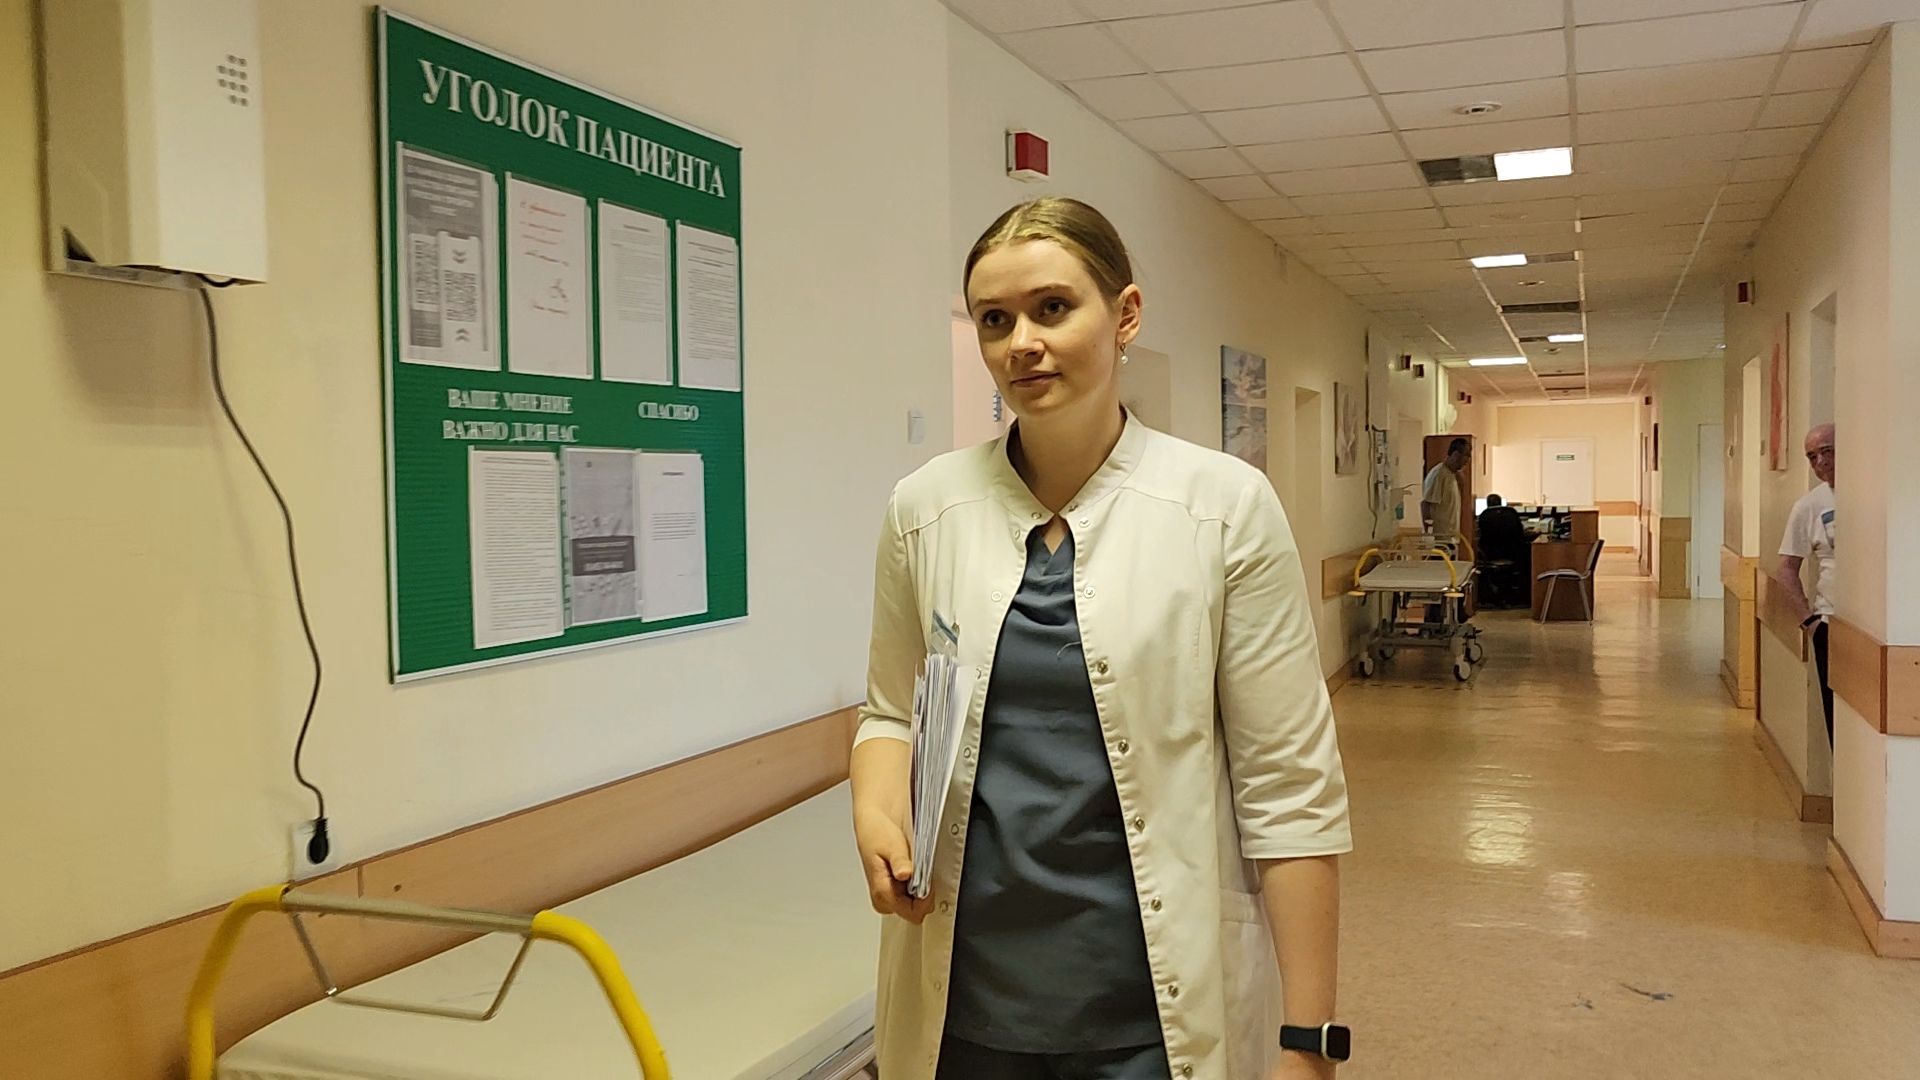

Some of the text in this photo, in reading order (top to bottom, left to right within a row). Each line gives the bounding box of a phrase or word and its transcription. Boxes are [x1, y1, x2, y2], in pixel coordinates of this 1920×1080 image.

[417, 59, 570, 148] УГОЛОК
[575, 115, 726, 198] ПАЦИЕНТА
[447, 388, 573, 414] ВАШЕ МНЕНИЕ
[638, 401, 699, 421] СПАСИБО
[442, 419, 580, 443] ВАЖНО ДЛЯ НАС
